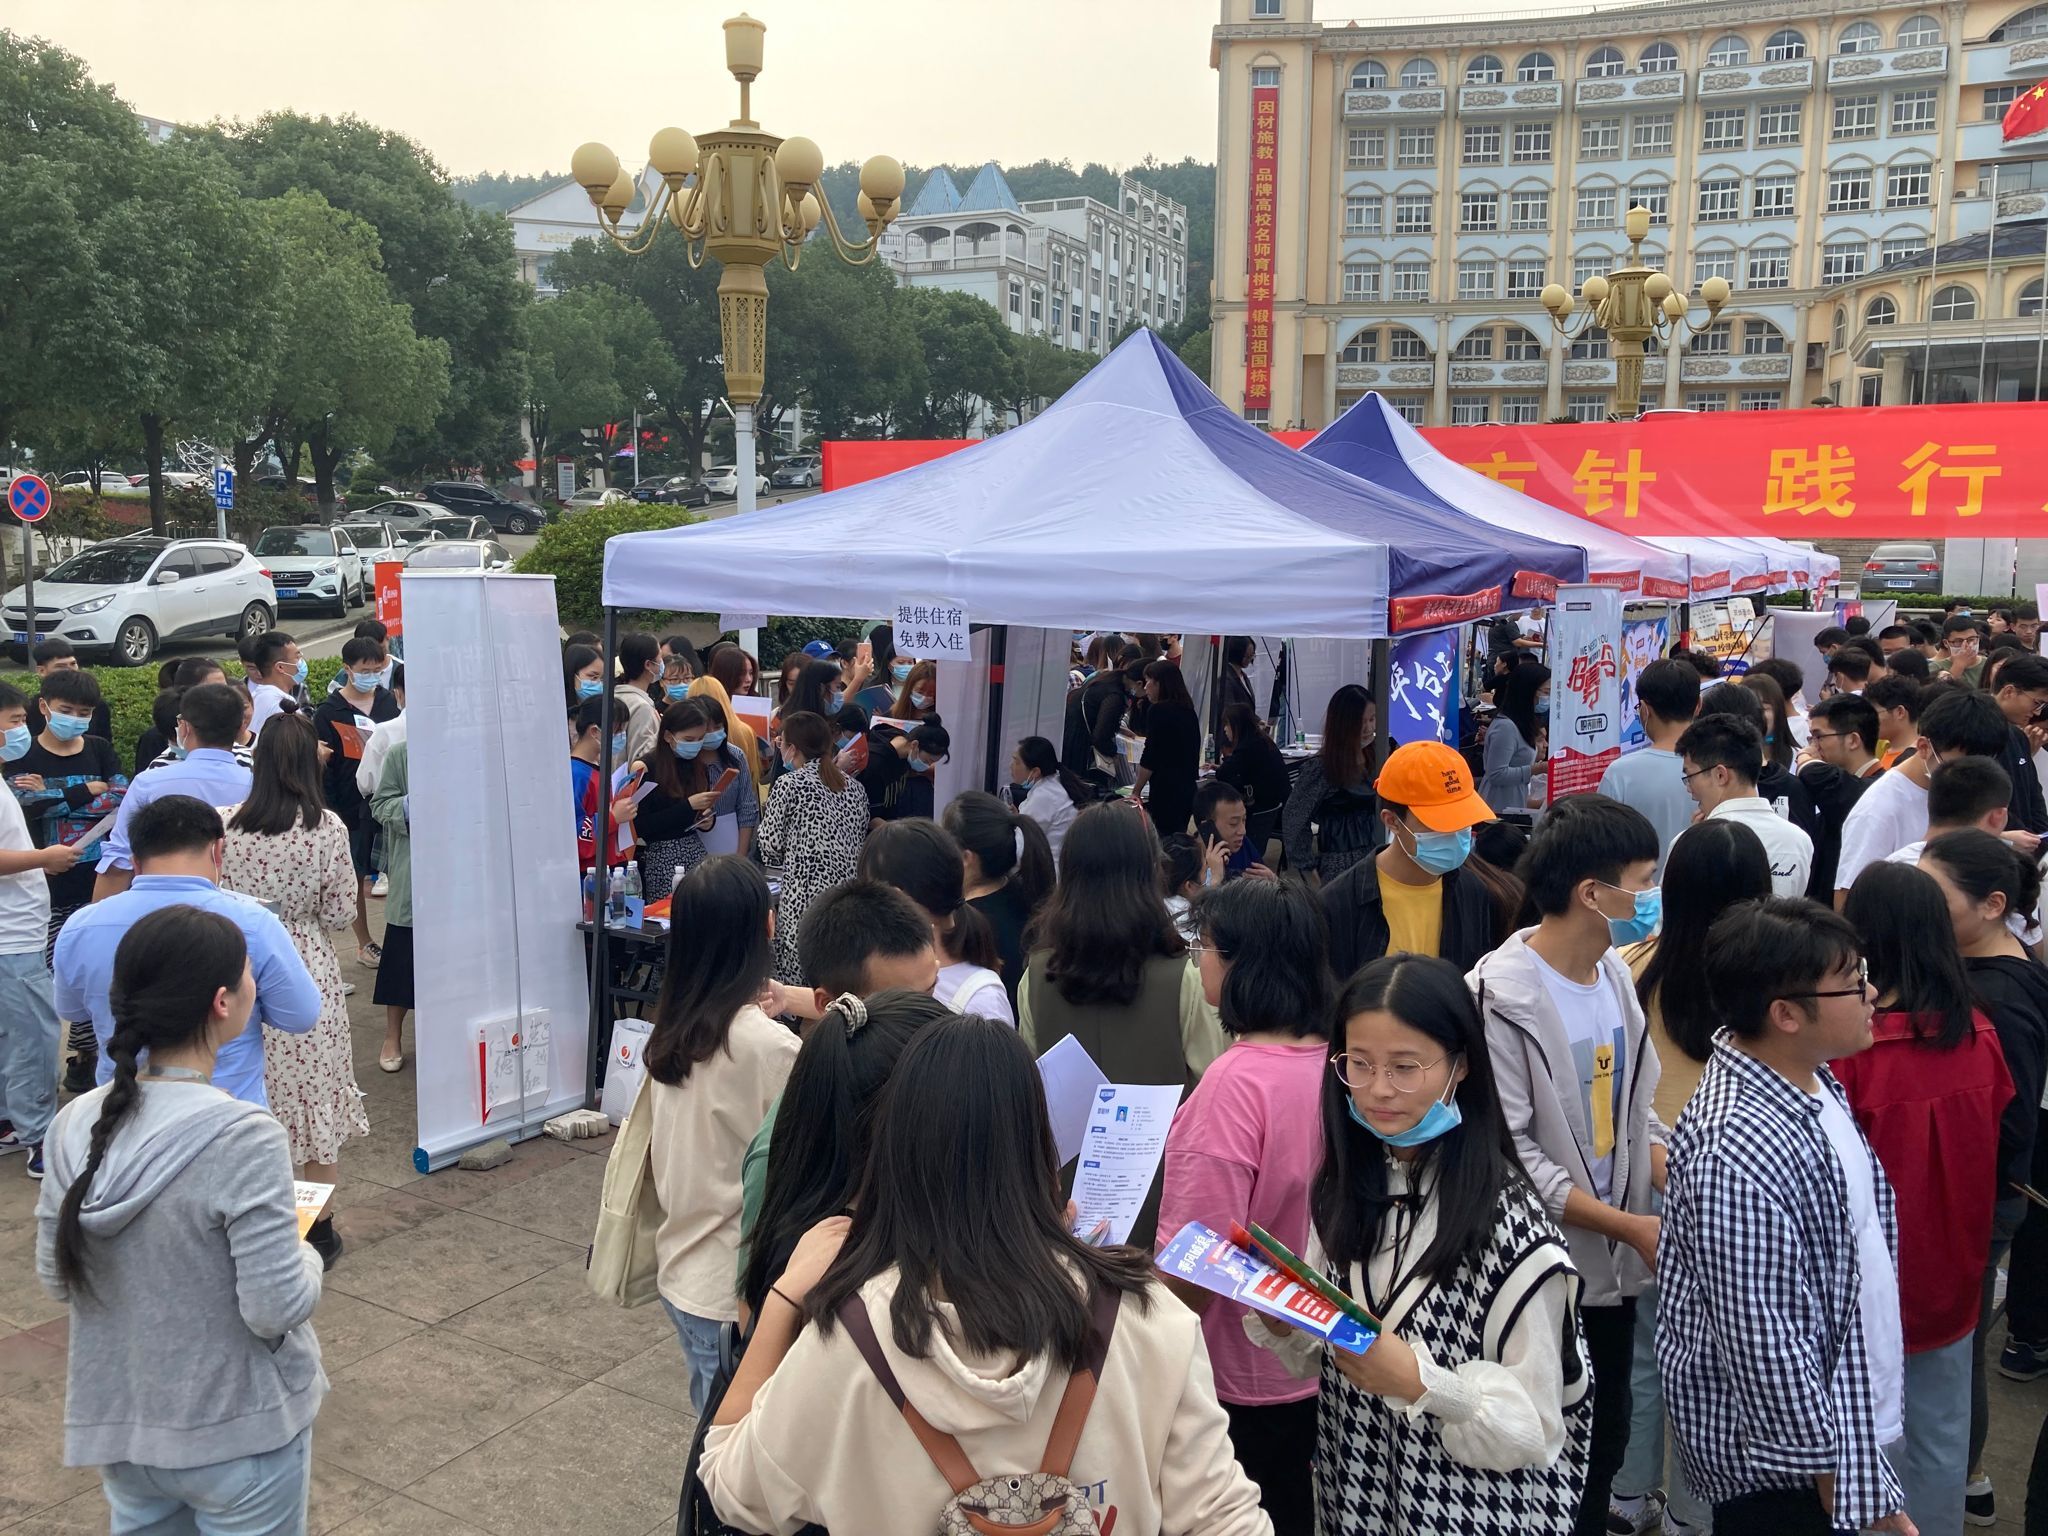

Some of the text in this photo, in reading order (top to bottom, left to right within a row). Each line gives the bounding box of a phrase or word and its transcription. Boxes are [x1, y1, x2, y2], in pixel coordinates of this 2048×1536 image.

[1249, 100, 1275, 398] 因材施教 品牌高校名师育桃李 锻造祖国栋梁
[217, 471, 228, 492] P
[1763, 441, 2048, 518] 践行
[897, 605, 962, 626] 提供住宿
[899, 629, 964, 651] 免费入住
[1445, 777, 1460, 788] good
[1447, 785, 1461, 794] time
[1771, 798, 1785, 806] ITE
[1770, 862, 1796, 877] land
